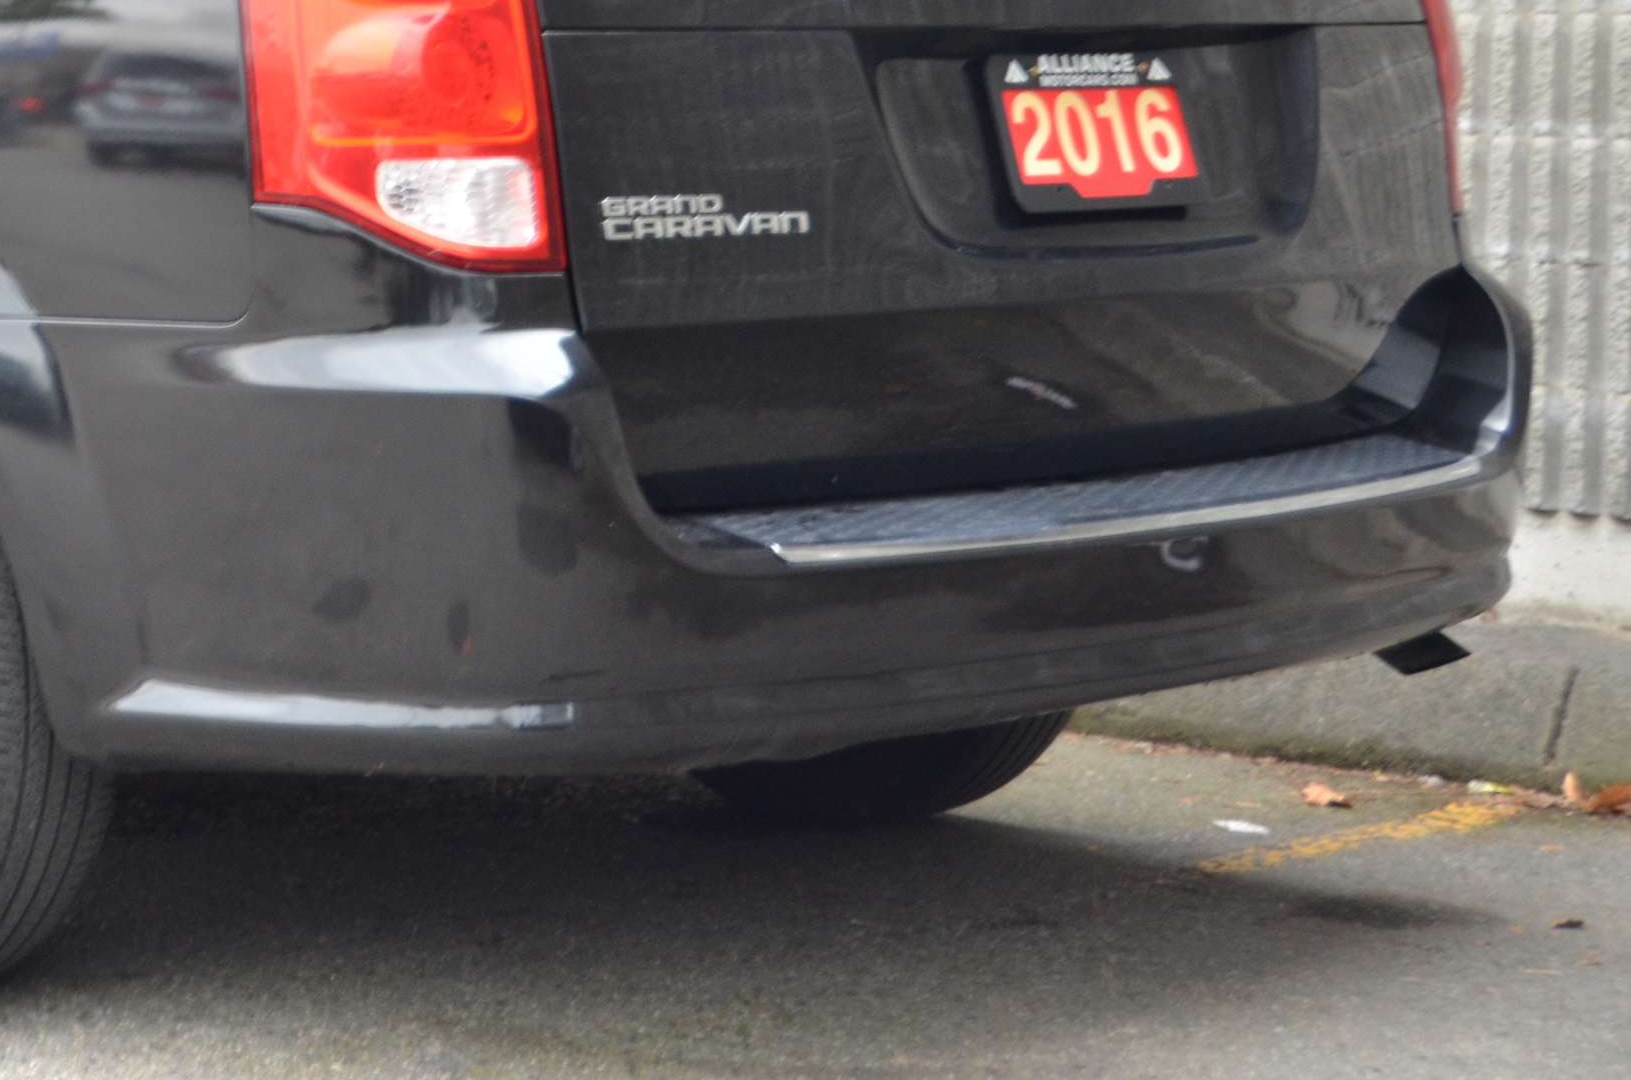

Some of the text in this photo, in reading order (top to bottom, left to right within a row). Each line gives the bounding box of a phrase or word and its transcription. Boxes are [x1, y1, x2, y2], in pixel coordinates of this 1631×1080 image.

[1037, 52, 1135, 73] ALLIANCE
[1011, 89, 1183, 176] 2016
[601, 193, 723, 217] GRAND
[601, 210, 811, 241] CARAVAN
